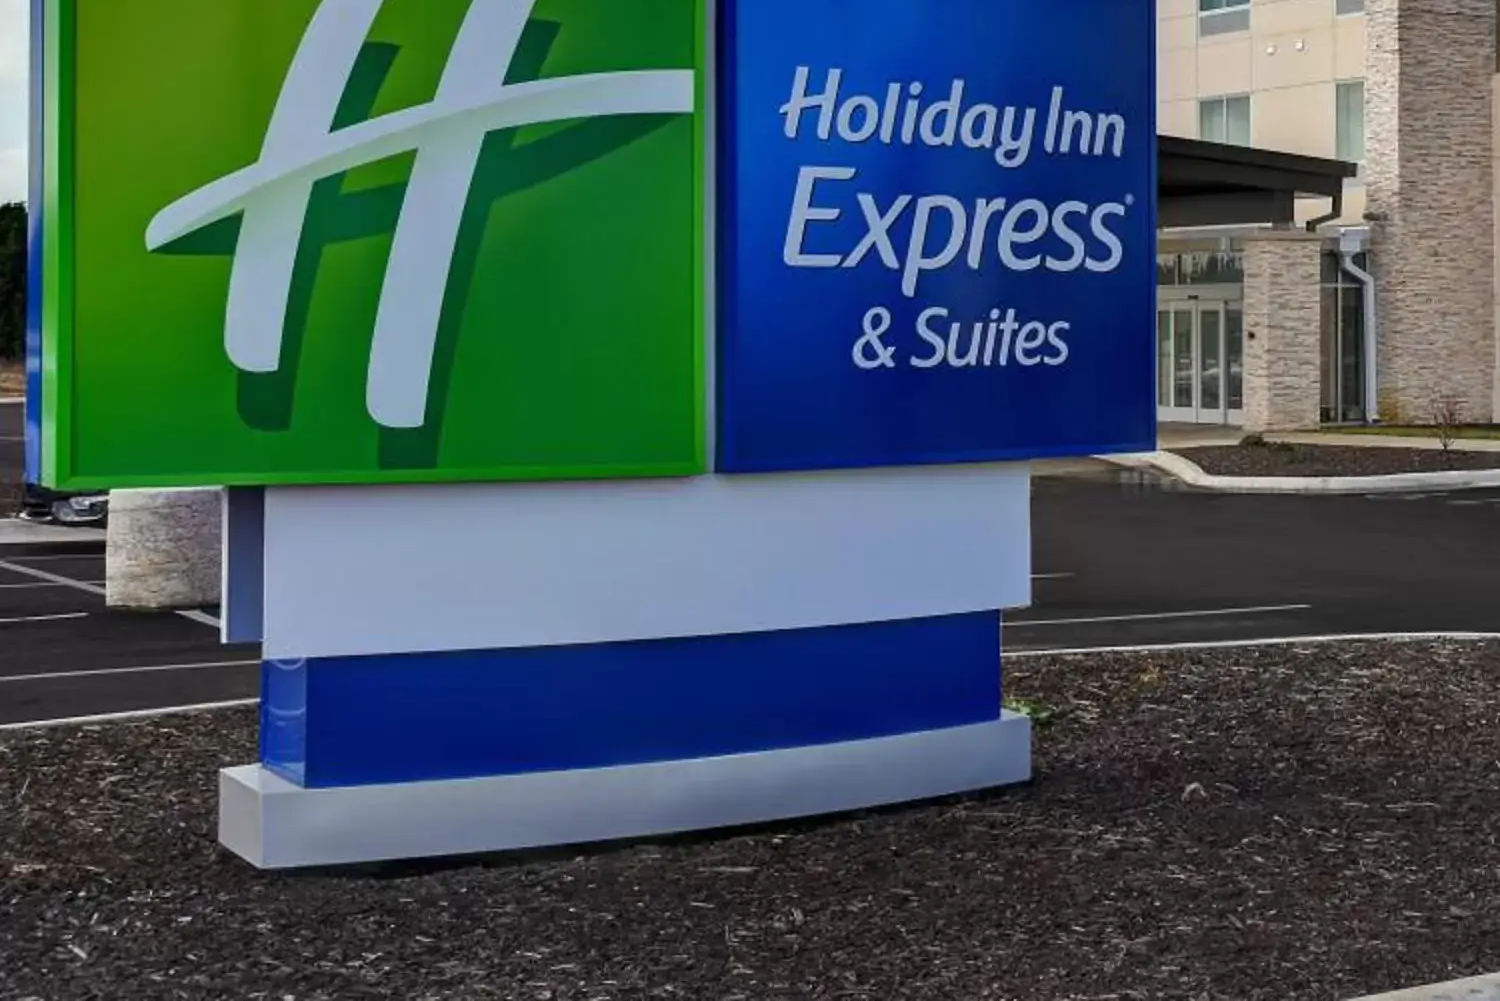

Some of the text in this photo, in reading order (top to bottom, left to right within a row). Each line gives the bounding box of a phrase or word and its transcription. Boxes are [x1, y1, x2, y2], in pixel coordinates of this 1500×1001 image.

[779, 65, 1126, 168] Holiday Inn
[783, 165, 1126, 298] Express
[852, 306, 1071, 370] & Suites
